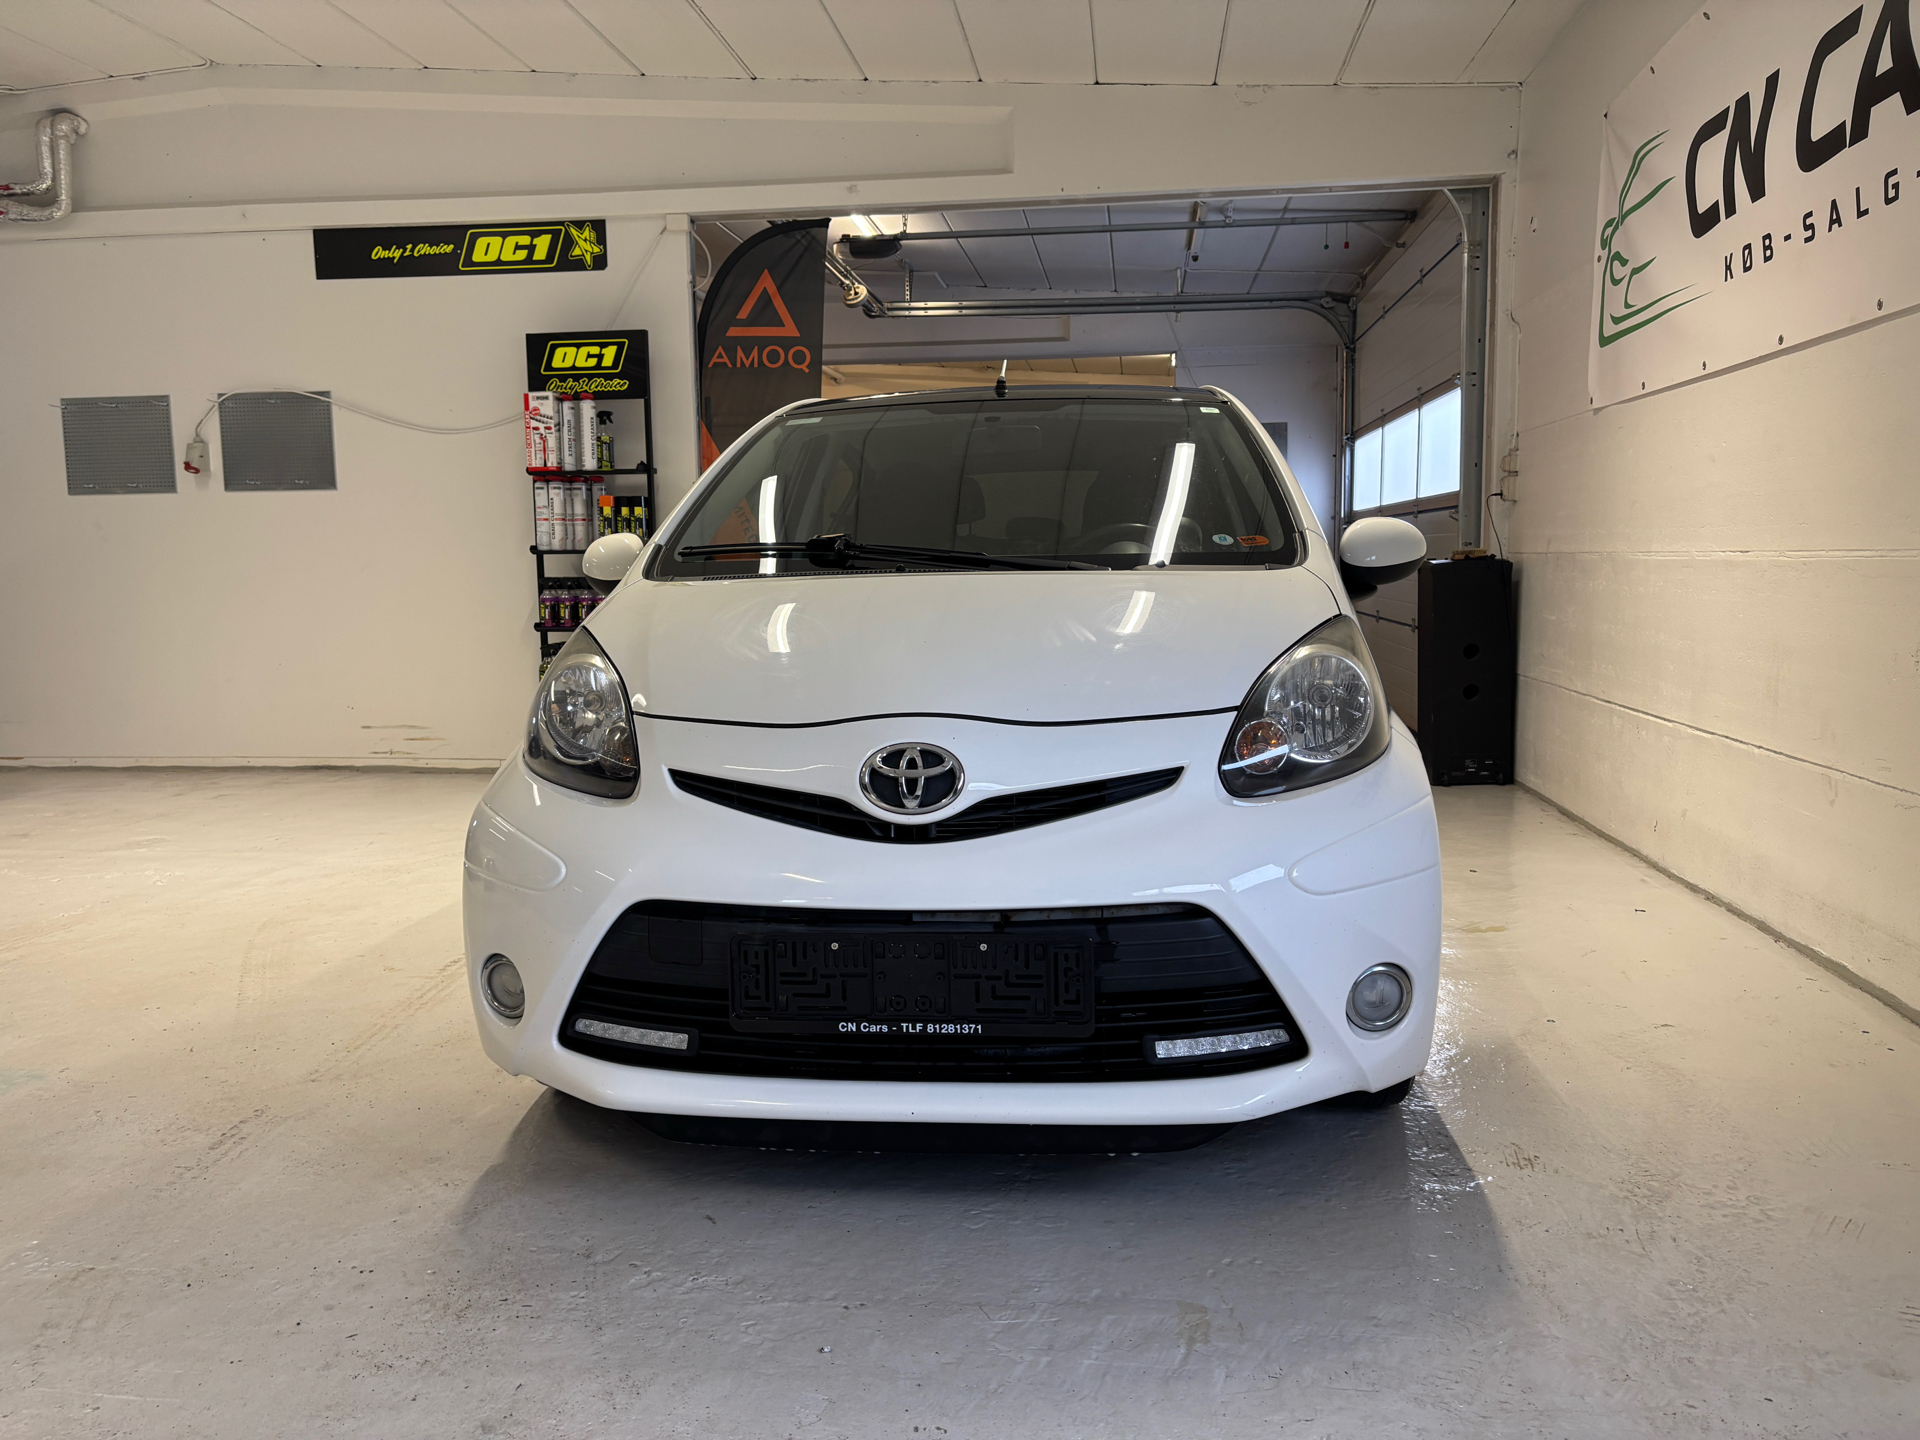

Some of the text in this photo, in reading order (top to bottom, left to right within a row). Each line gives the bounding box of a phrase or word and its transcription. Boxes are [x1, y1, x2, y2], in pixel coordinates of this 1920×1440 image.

[1685, 68, 1780, 238] CN
[371, 243, 455, 264] Only 1 Choice
[471, 234, 553, 263] OC1
[551, 345, 618, 368] OC1
[707, 345, 811, 373] AMOQ
[546, 377, 579, 395] Only
[587, 377, 630, 393] Choice
[524, 410, 532, 428] CARE
[525, 429, 533, 449] CHAIN
[838, 1022, 857, 1032] CN
[860, 1022, 889, 1033] Cars
[900, 1023, 923, 1033] TLF
[926, 1023, 982, 1034] 81281371
